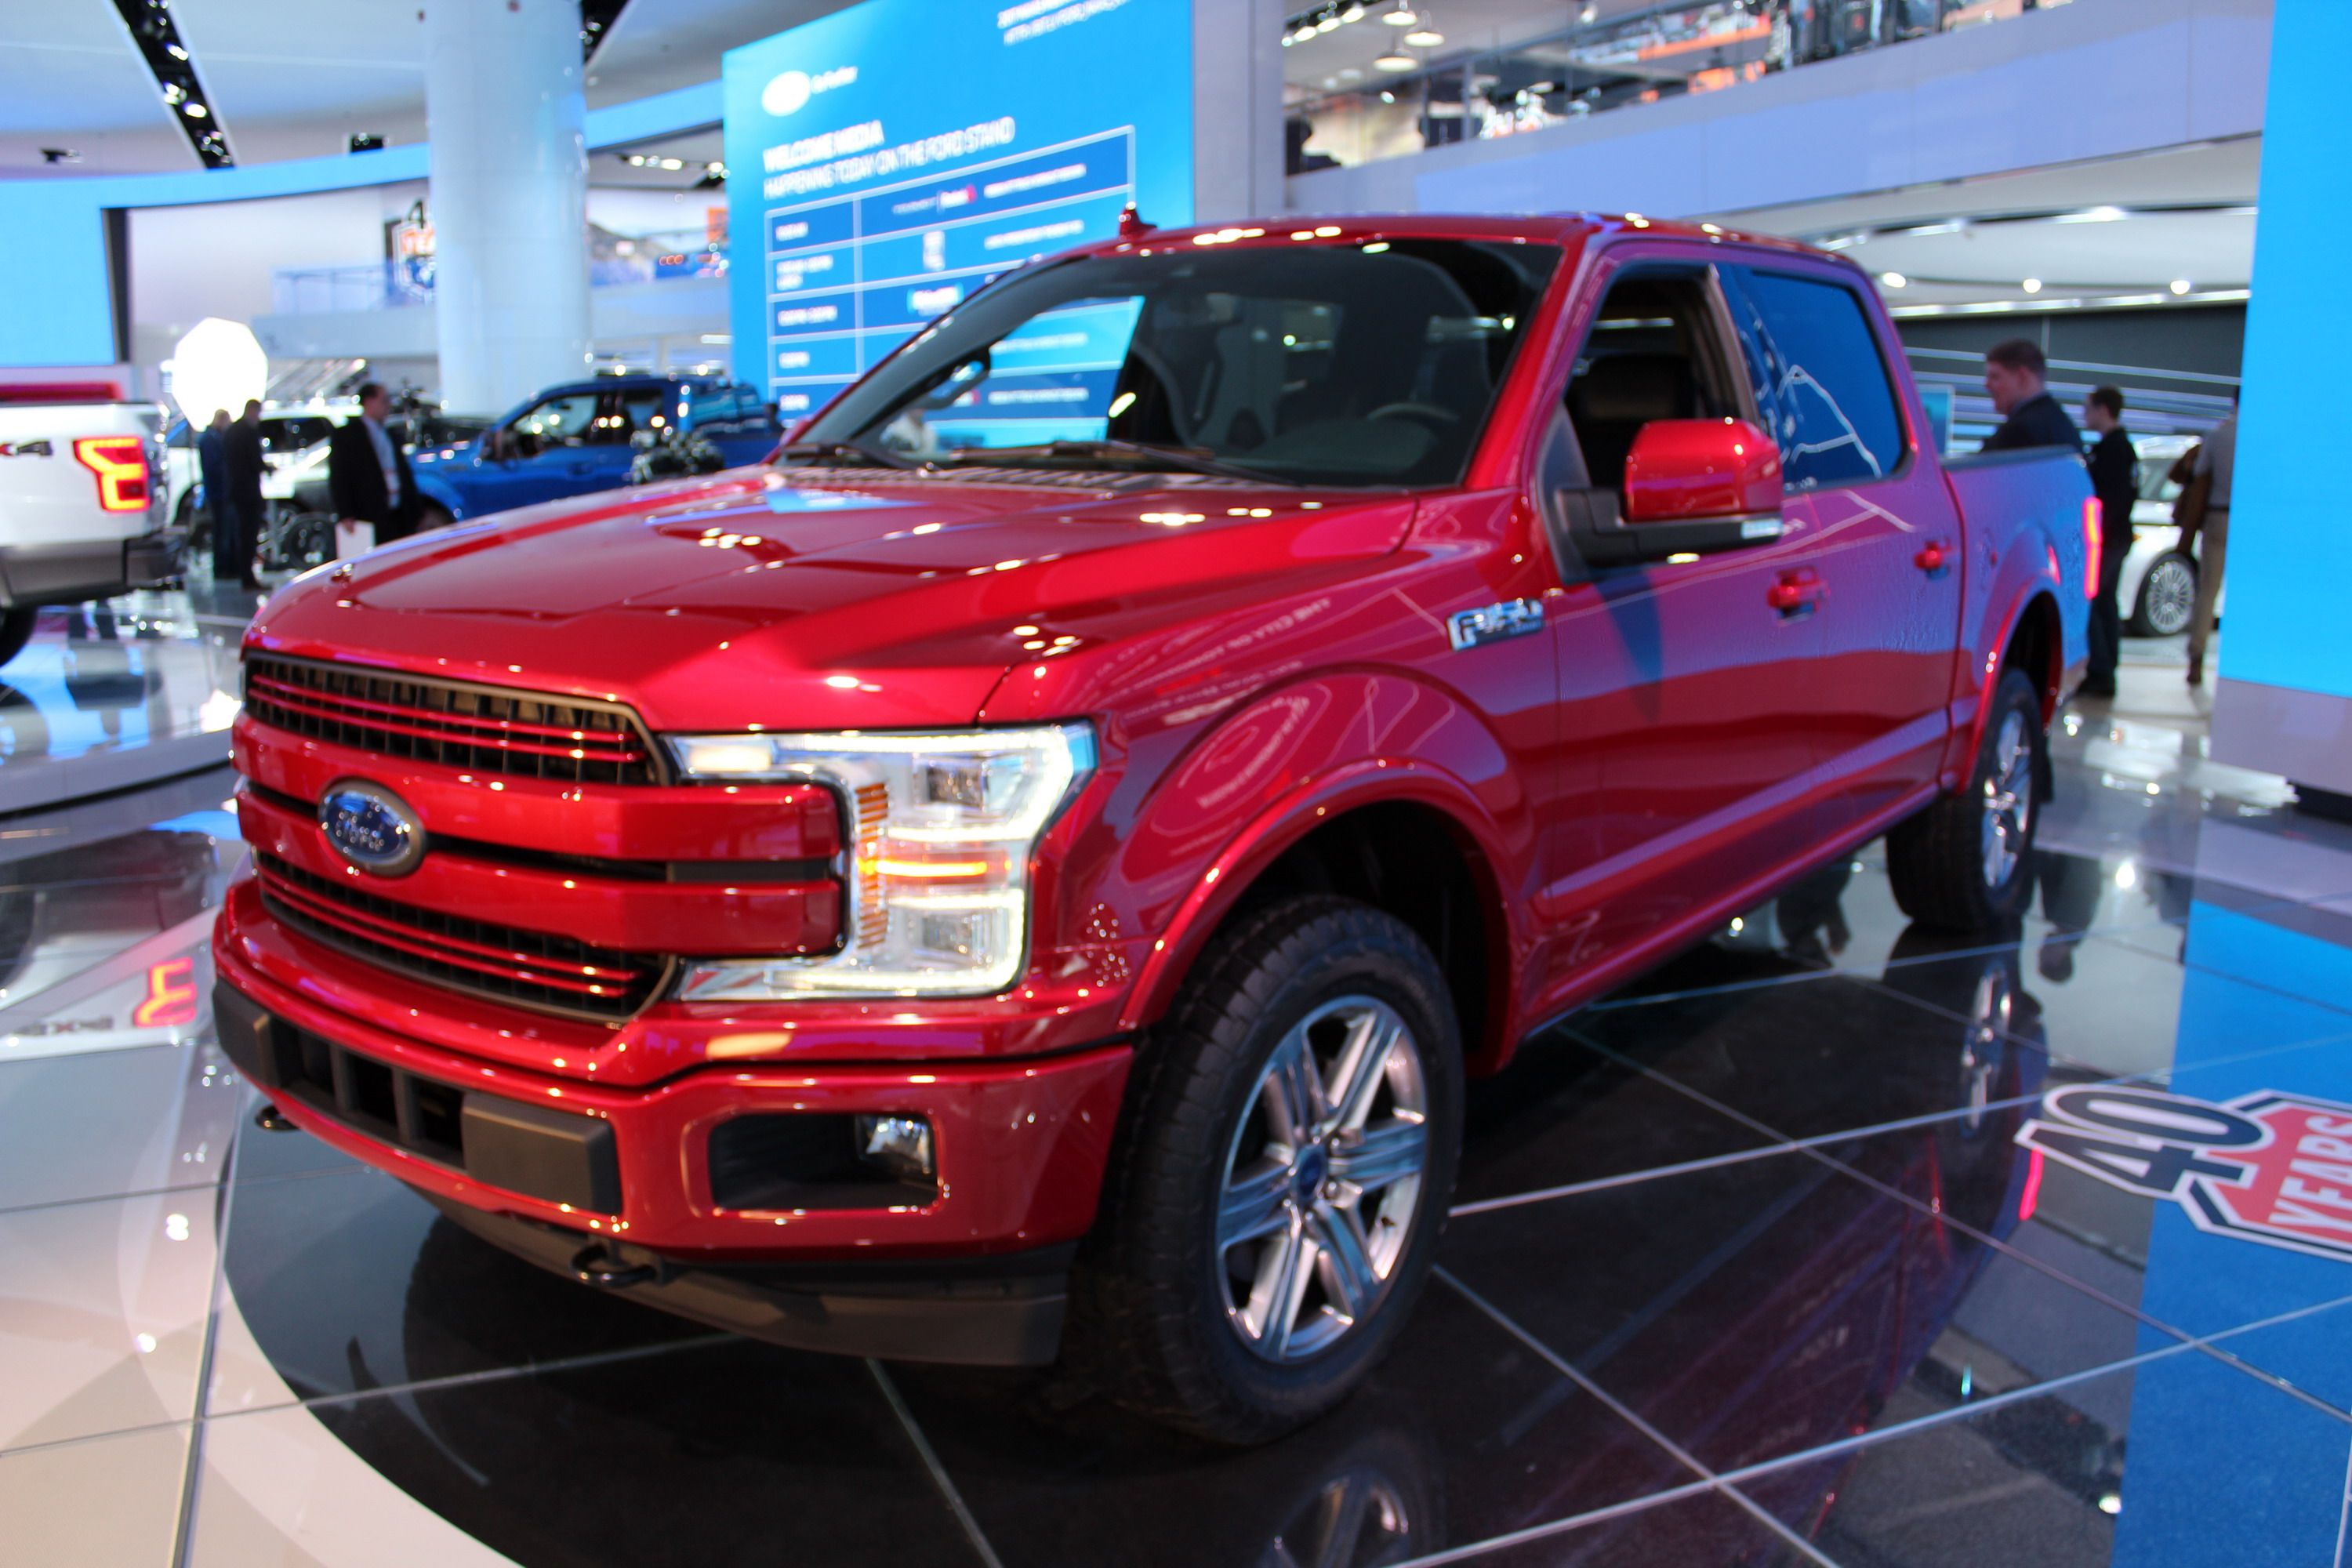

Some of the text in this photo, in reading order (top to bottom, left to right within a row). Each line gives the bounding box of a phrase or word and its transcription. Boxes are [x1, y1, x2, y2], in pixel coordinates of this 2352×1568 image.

[835, 153, 876, 184] TODAY
[926, 130, 965, 162] FORD
[965, 116, 1016, 154] STAND
[2014, 1084, 2274, 1201] 40
